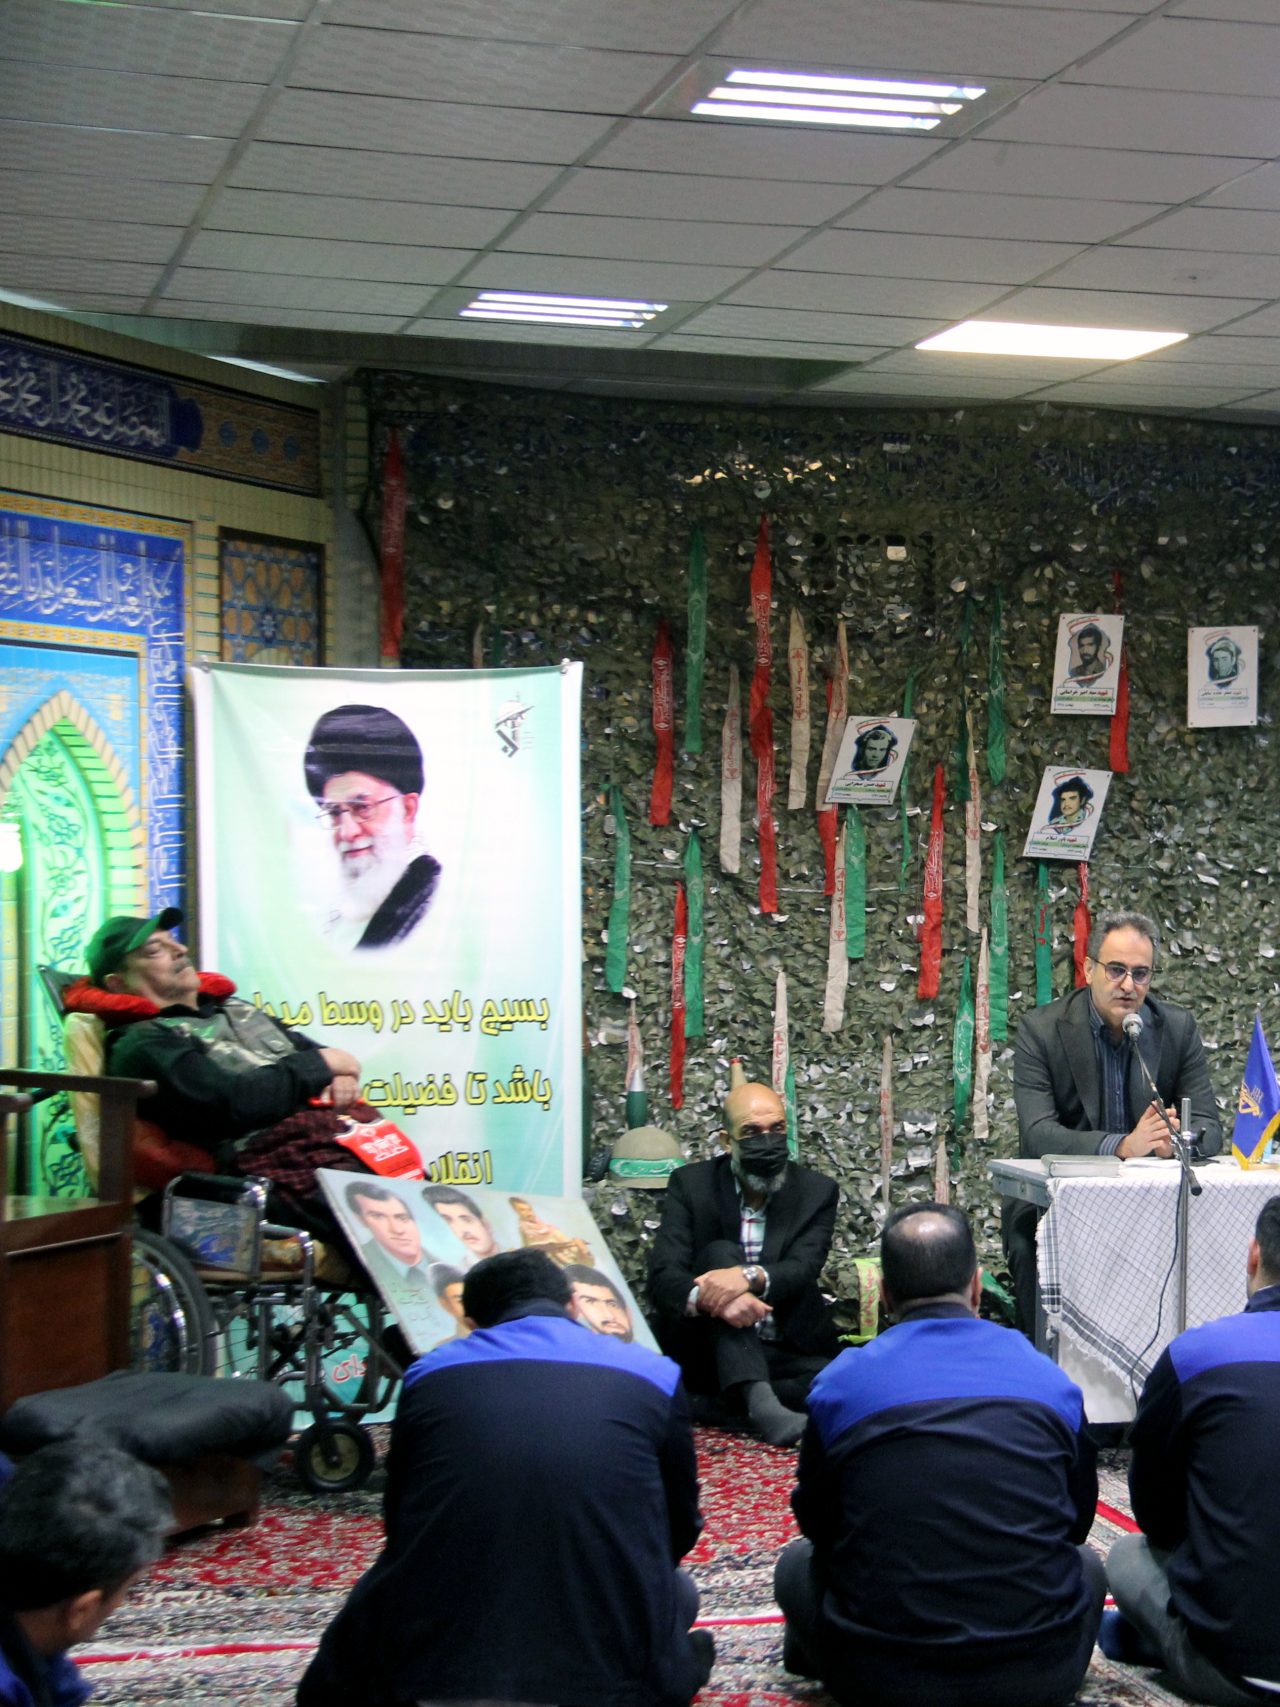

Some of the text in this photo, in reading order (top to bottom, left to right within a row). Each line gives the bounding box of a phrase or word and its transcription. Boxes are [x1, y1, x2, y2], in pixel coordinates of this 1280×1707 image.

[318, 991, 384, 1033] وسط
[390, 999, 416, 1033] در
[422, 990, 473, 1033] باید
[480, 995, 550, 1036] بسیج
[362, 1064, 553, 1116] باشد تا فضیلت
